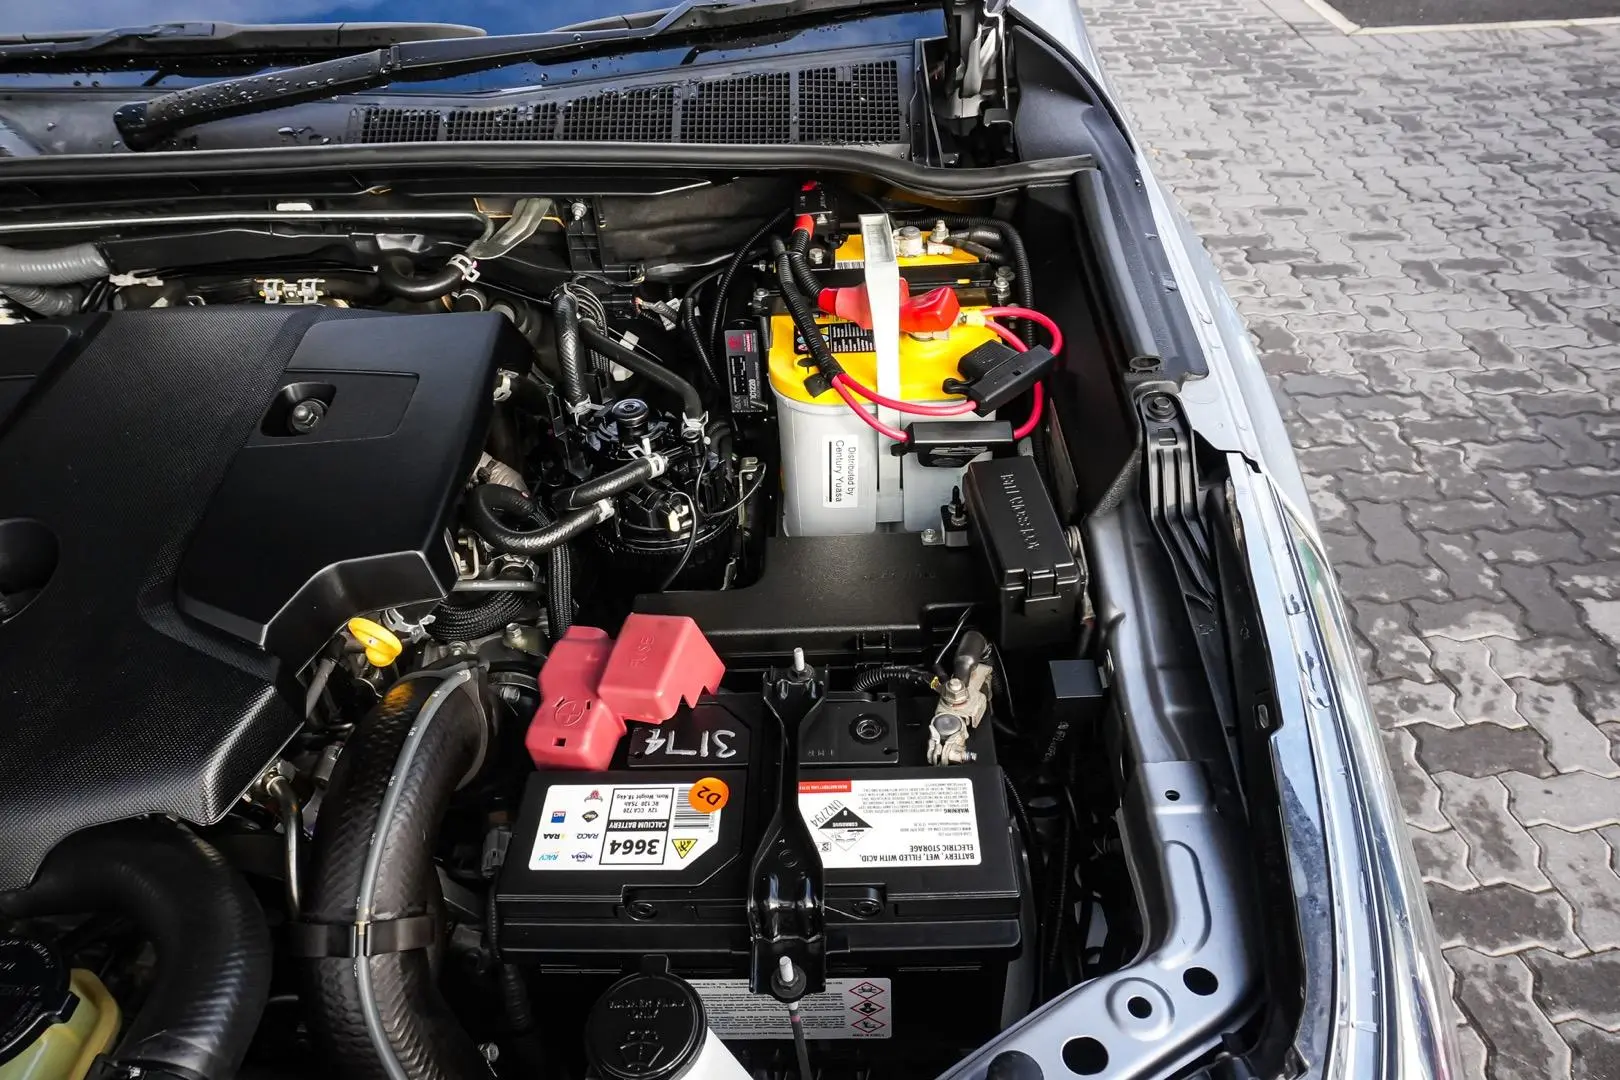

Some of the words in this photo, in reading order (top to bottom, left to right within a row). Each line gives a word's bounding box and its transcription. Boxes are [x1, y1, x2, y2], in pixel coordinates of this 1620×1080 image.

[833, 440, 844, 474] Century
[847, 446, 856, 486] Distributed
[835, 476, 844, 502] Yuasa
[846, 487, 856, 496] by
[697, 786, 722, 806] D2
[809, 800, 844, 828] UN2794
[610, 839, 660, 855] 3664
[923, 853, 940, 861] WET,
